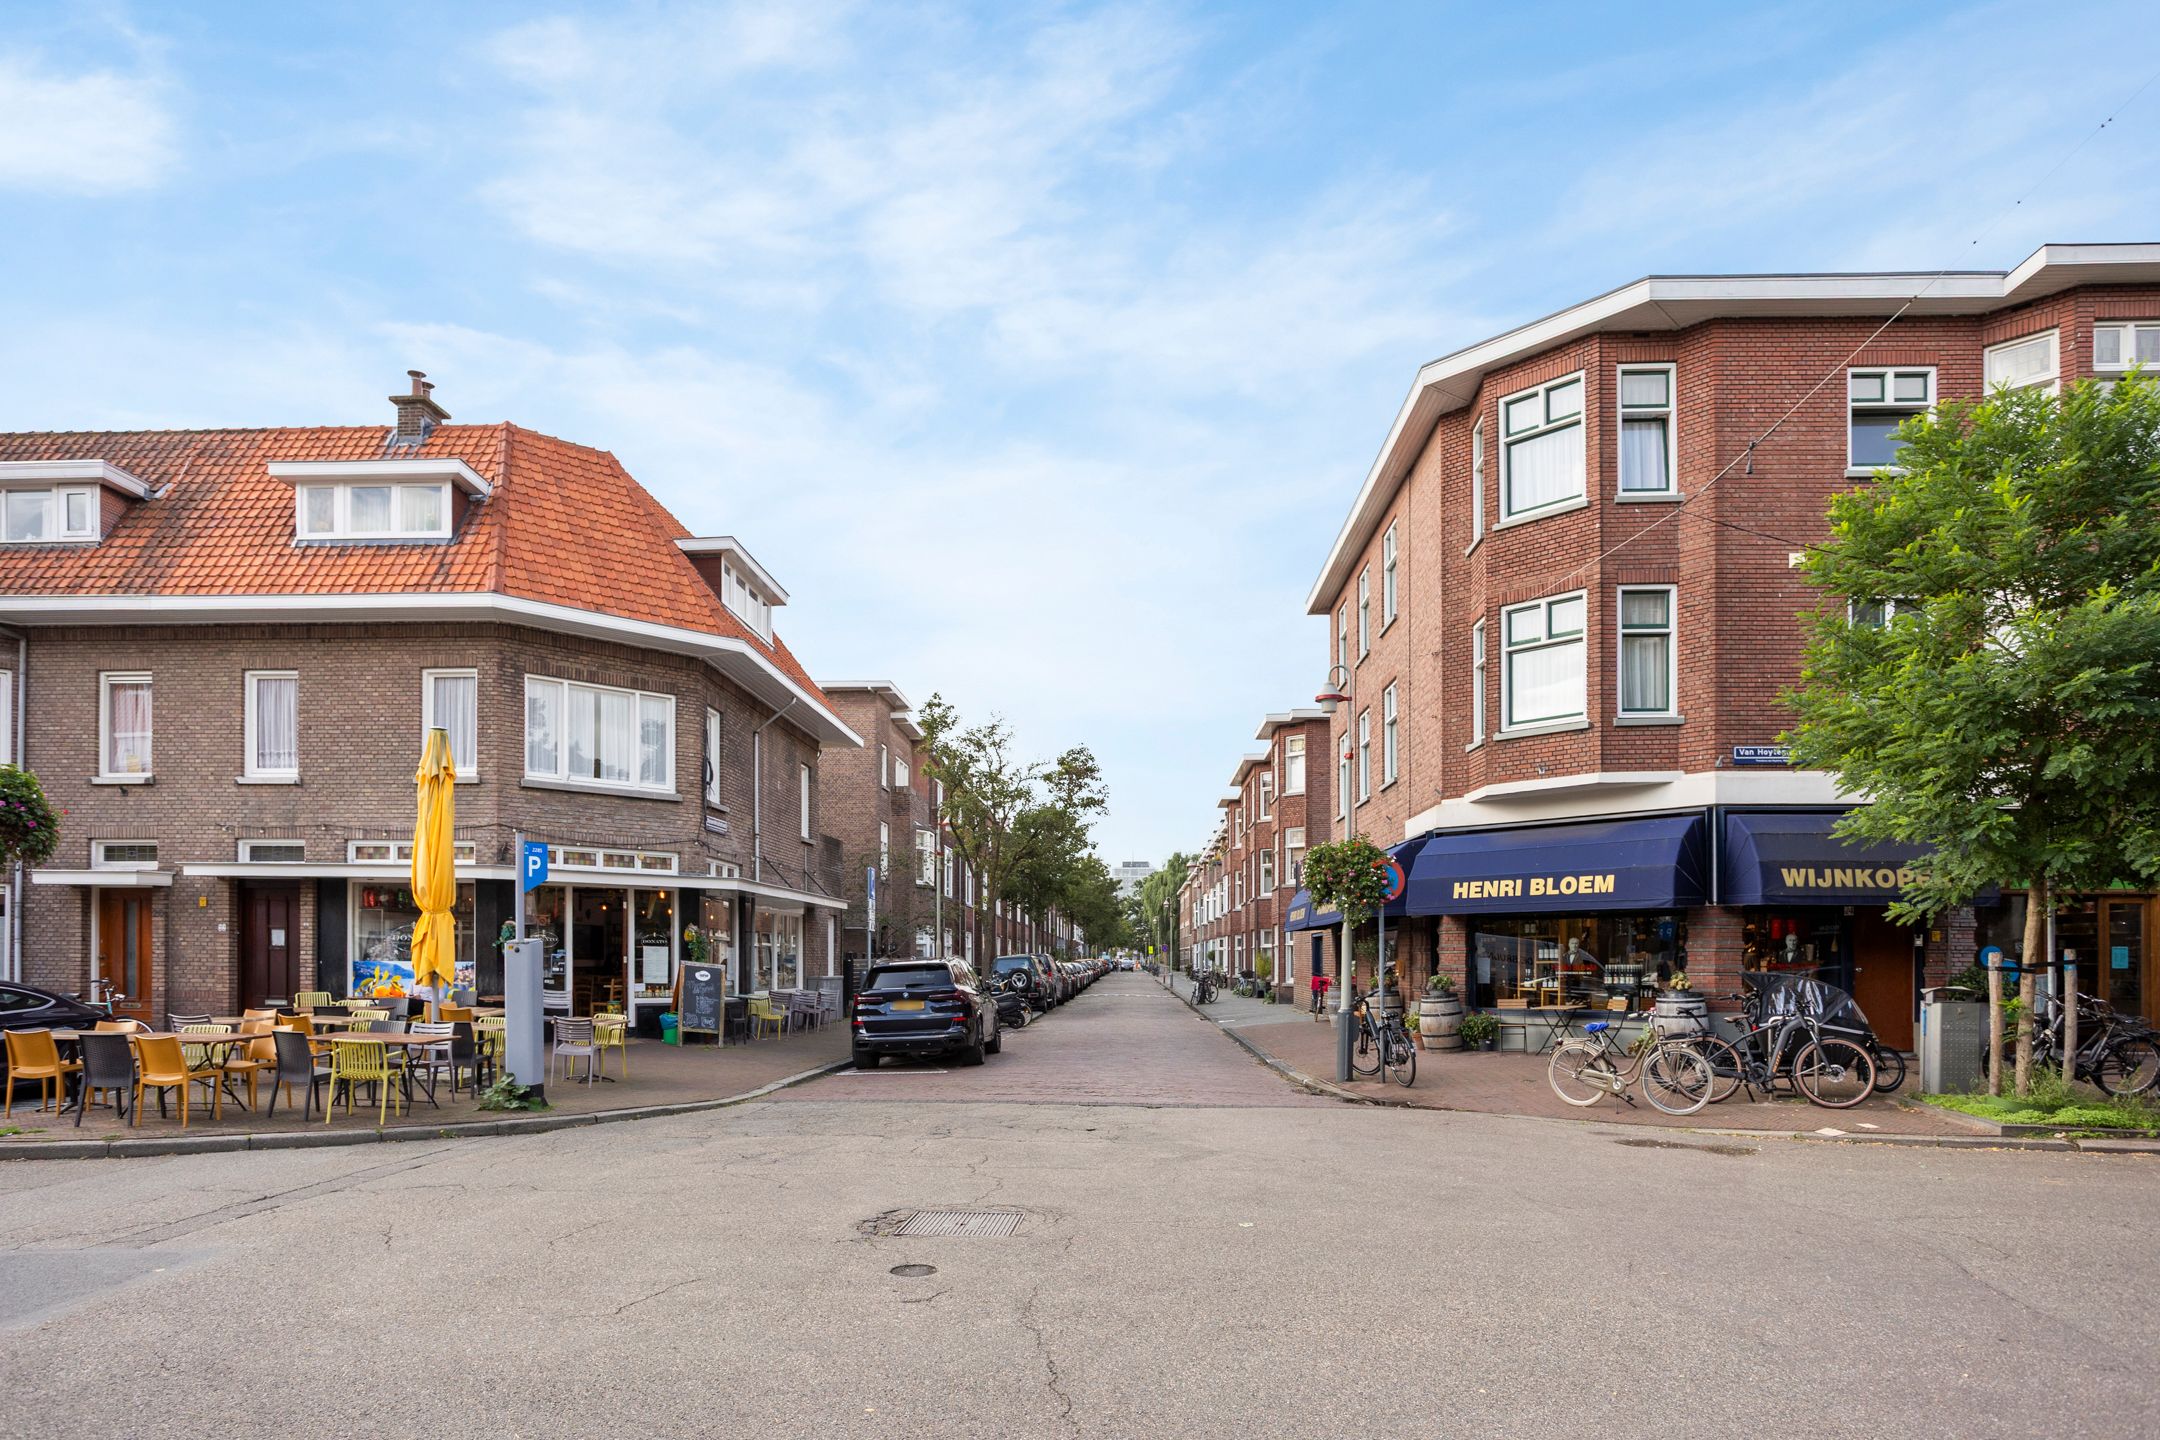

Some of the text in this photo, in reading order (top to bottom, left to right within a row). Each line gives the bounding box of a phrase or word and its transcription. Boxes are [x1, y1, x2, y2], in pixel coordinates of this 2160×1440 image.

[1739, 748, 1754, 756] Van
[528, 855, 542, 878] P
[1453, 874, 1615, 899] HENRI BLOEM
